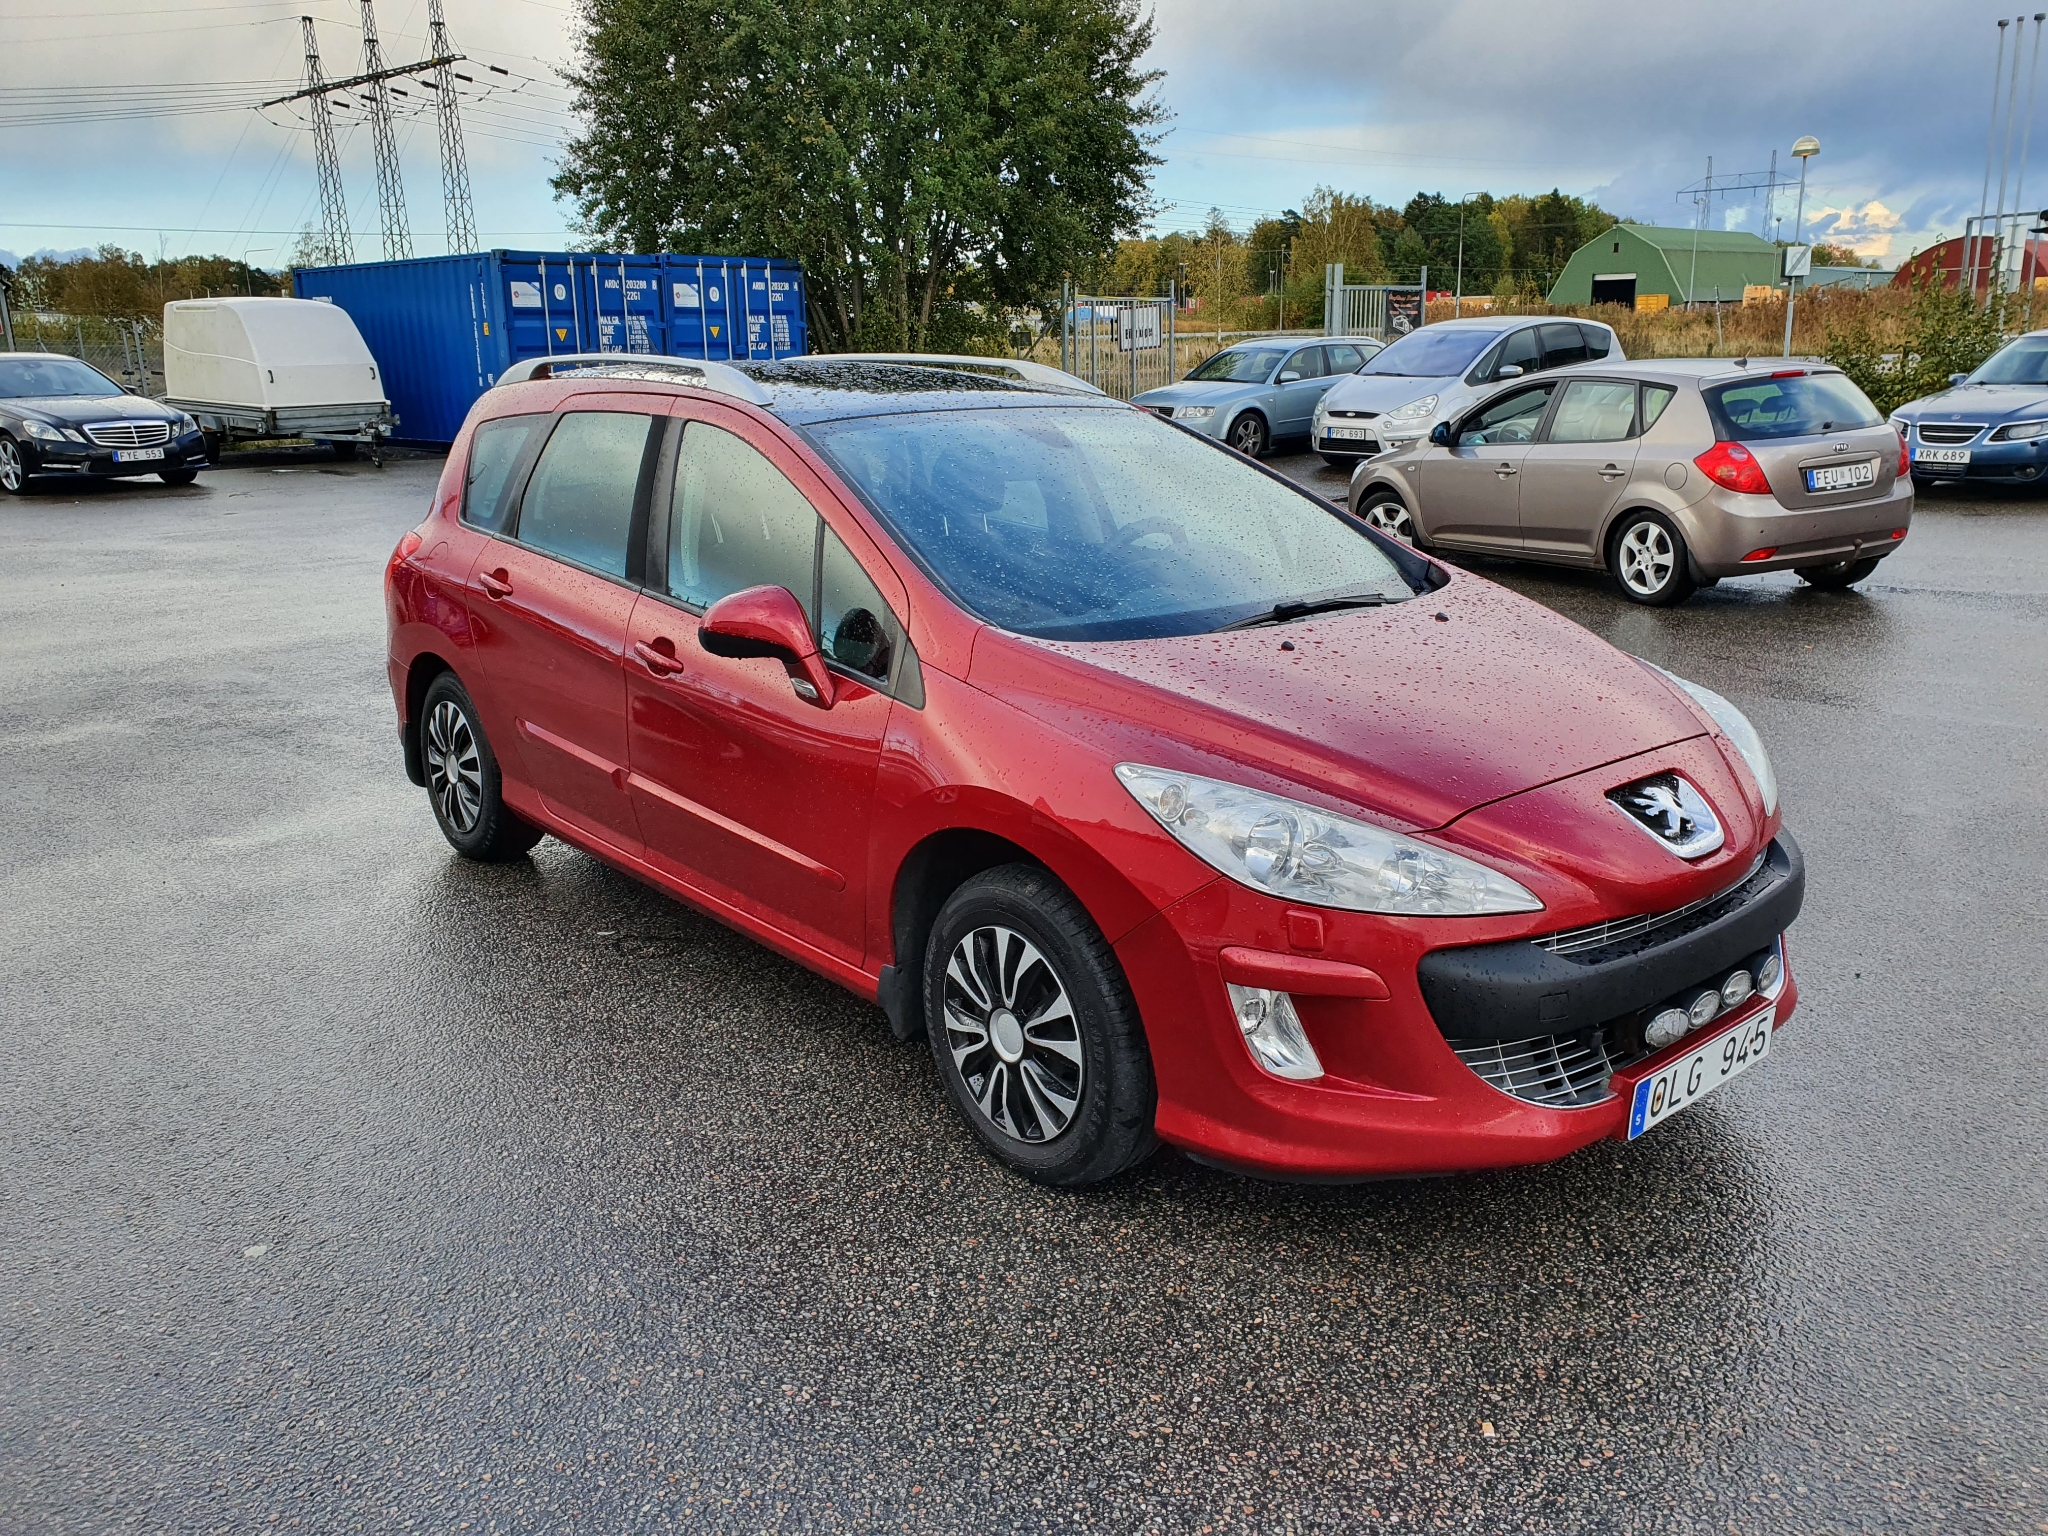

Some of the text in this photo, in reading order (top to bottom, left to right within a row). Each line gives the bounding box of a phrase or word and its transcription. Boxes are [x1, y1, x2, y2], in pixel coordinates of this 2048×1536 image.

[753, 282, 765, 290] ARDU
[627, 292, 640, 300] 22G1
[772, 293, 783, 301] 22G1
[602, 326, 615, 334] TARE
[750, 324, 761, 332] TARE
[602, 336, 612, 344] NET
[1332, 429, 1363, 438] PPG 693
[120, 450, 162, 460] FYE 553
[1918, 450, 1966, 461] XRK 689
[1815, 466, 1870, 486] FEU 102
[1650, 1056, 1704, 1118] OLG
[1720, 1016, 1768, 1076] 945
